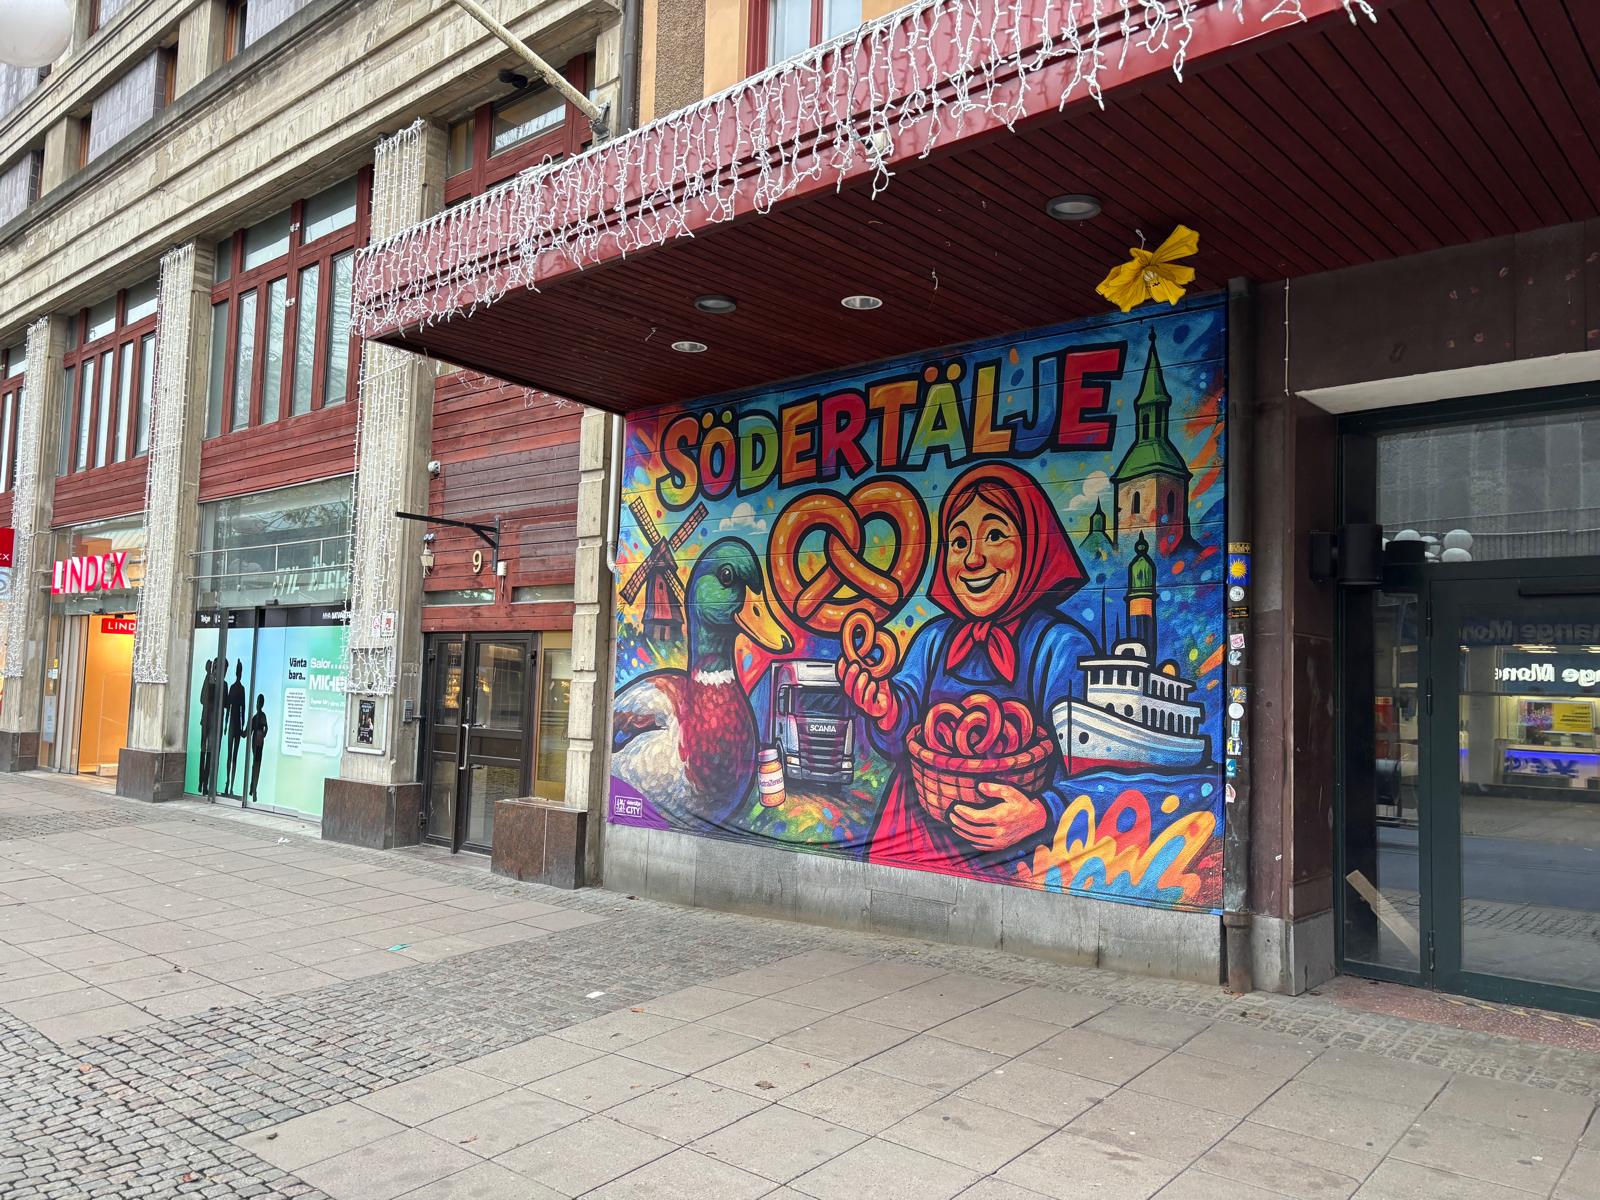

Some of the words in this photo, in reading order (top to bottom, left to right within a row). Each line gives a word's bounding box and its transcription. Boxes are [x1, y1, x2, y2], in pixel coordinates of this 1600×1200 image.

[656, 341, 1127, 512] SÖDERTÄLJE
[472, 550, 483, 574] 9
[51, 551, 130, 594] LINDEX
[289, 657, 307, 668] Vänta
[809, 724, 837, 733] SCANIA
[625, 806, 641, 815] CITY
